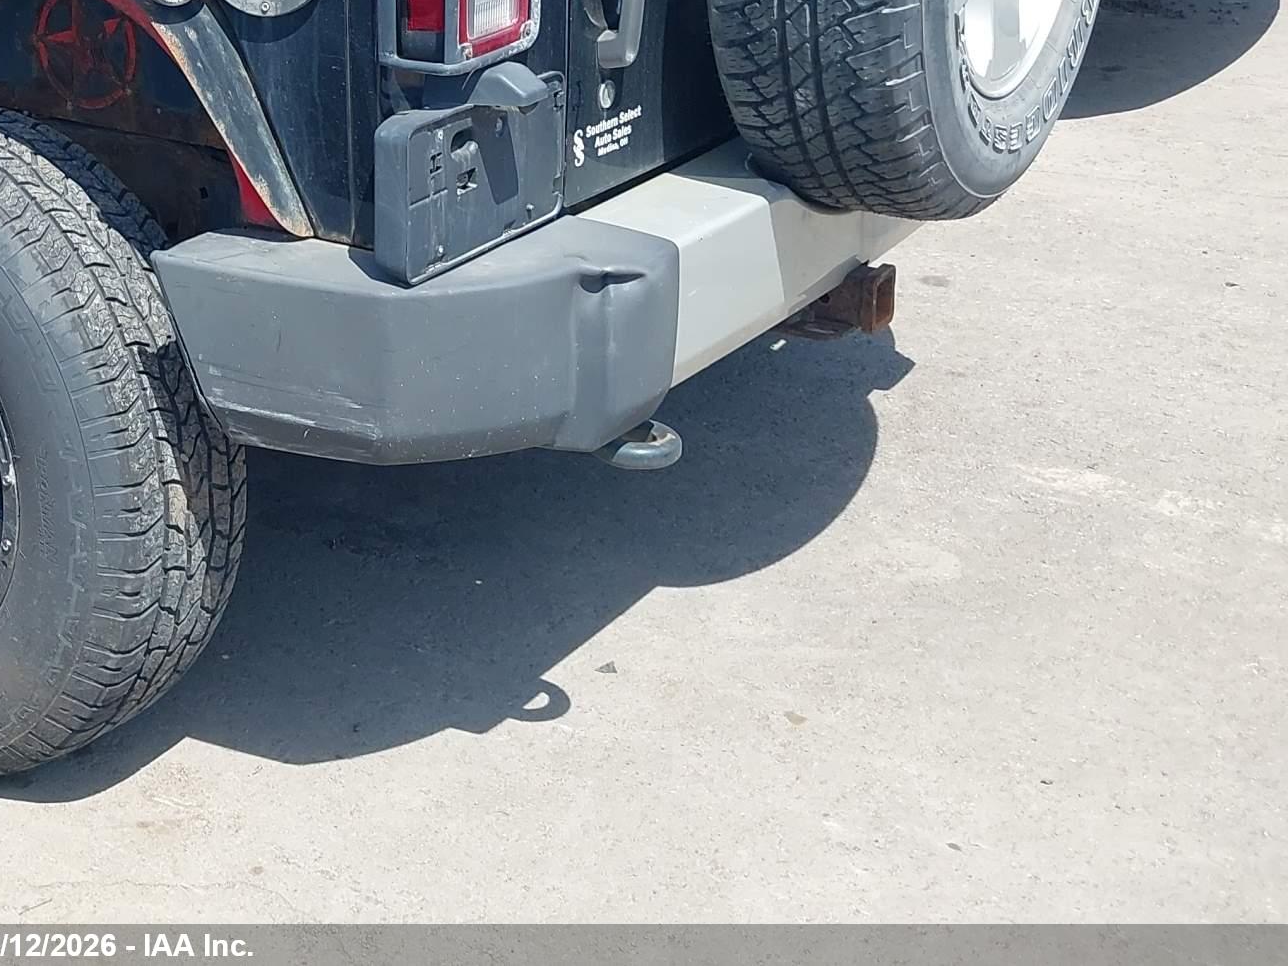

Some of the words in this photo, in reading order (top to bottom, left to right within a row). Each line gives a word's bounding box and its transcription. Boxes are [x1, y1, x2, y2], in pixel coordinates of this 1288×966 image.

[586, 117, 619, 138] Southern
[619, 105, 642, 124] Select
[595, 133, 612, 149] Auto
[612, 125, 632, 141] Sales
